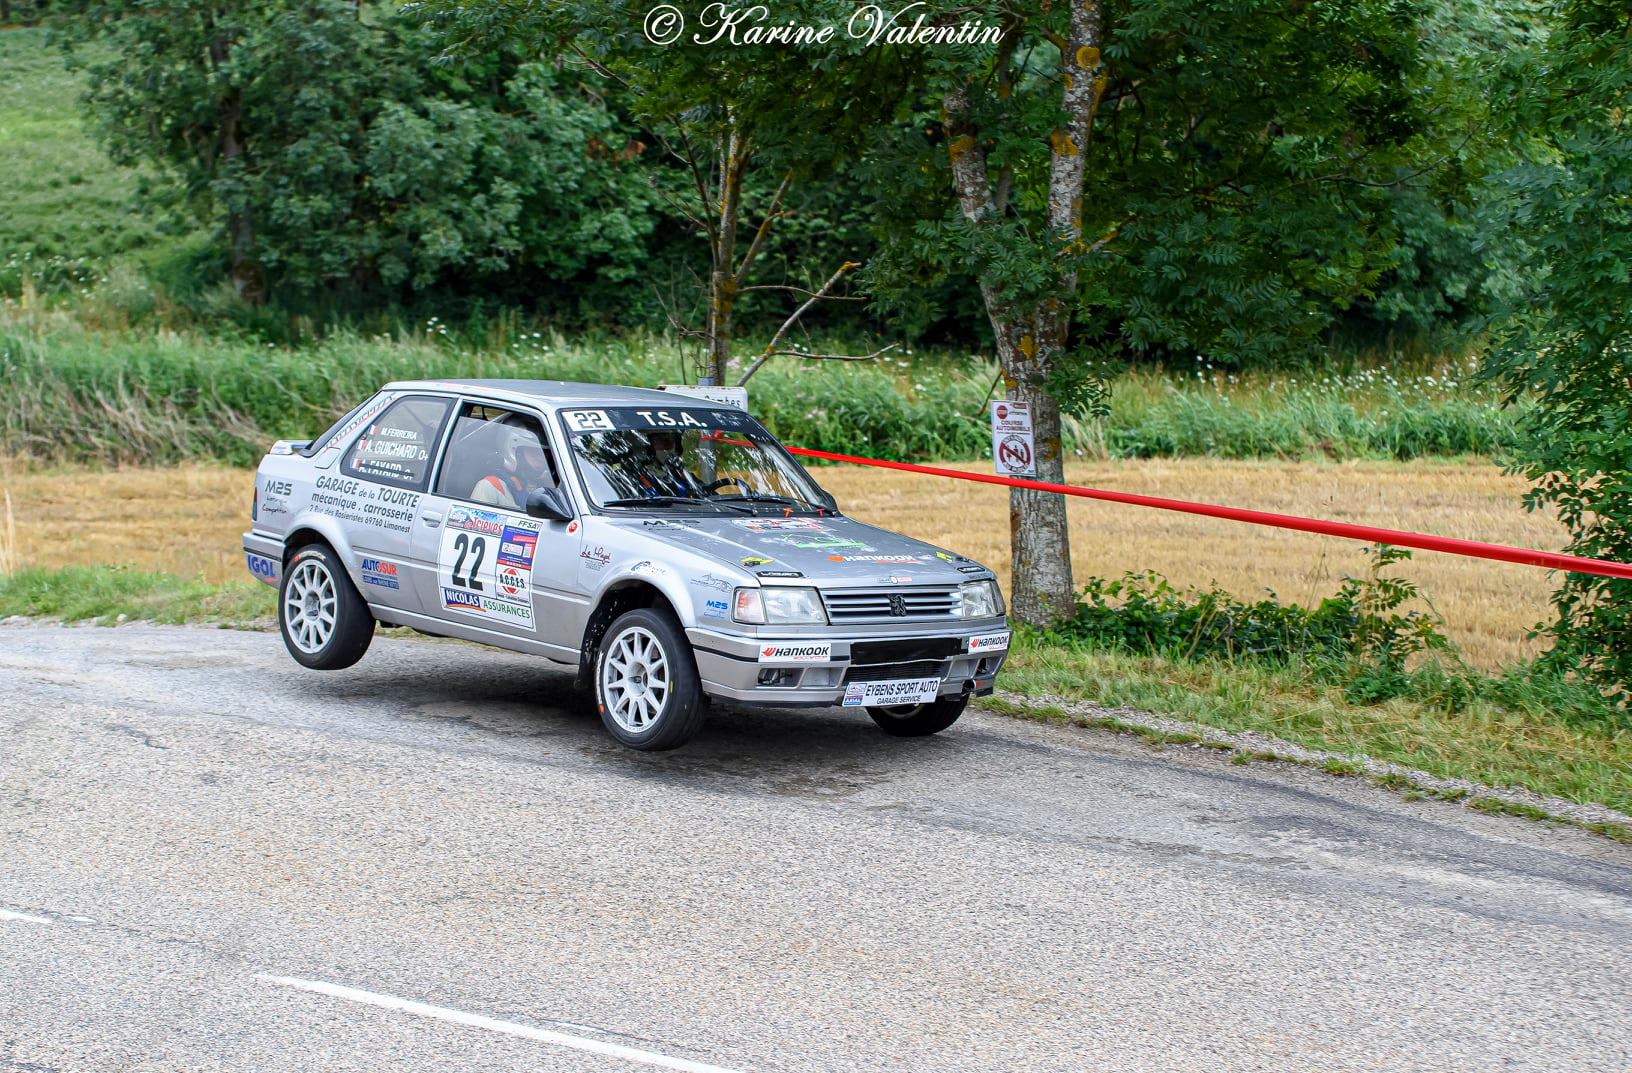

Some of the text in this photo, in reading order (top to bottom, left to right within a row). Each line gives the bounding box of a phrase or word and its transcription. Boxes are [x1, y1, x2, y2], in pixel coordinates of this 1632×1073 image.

[574, 412, 607, 429] 22
[636, 410, 708, 428] T.S.A.
[375, 441, 417, 459] GUICHARD
[264, 479, 293, 497] M2S
[316, 475, 420, 508] GARAGE de la TOURTE
[311, 491, 357, 511] mécanique
[363, 502, 413, 522] carrosserie
[324, 507, 335, 517] des
[364, 516, 383, 527] 69760
[383, 519, 411, 534] Limonest
[517, 520, 537, 530] FFSA
[247, 554, 276, 578] IGOL
[361, 559, 397, 576] AUTOSUR
[452, 533, 486, 591] 22
[445, 590, 480, 606] NICOLAS
[483, 600, 531, 619] ASSURANCES
[706, 600, 728, 610] M2S
[865, 683, 895, 697] EYBENS
[895, 681, 919, 695] SPORT
[919, 680, 938, 693] AUTO
[876, 694, 921, 705] GARAGE SERVICE
